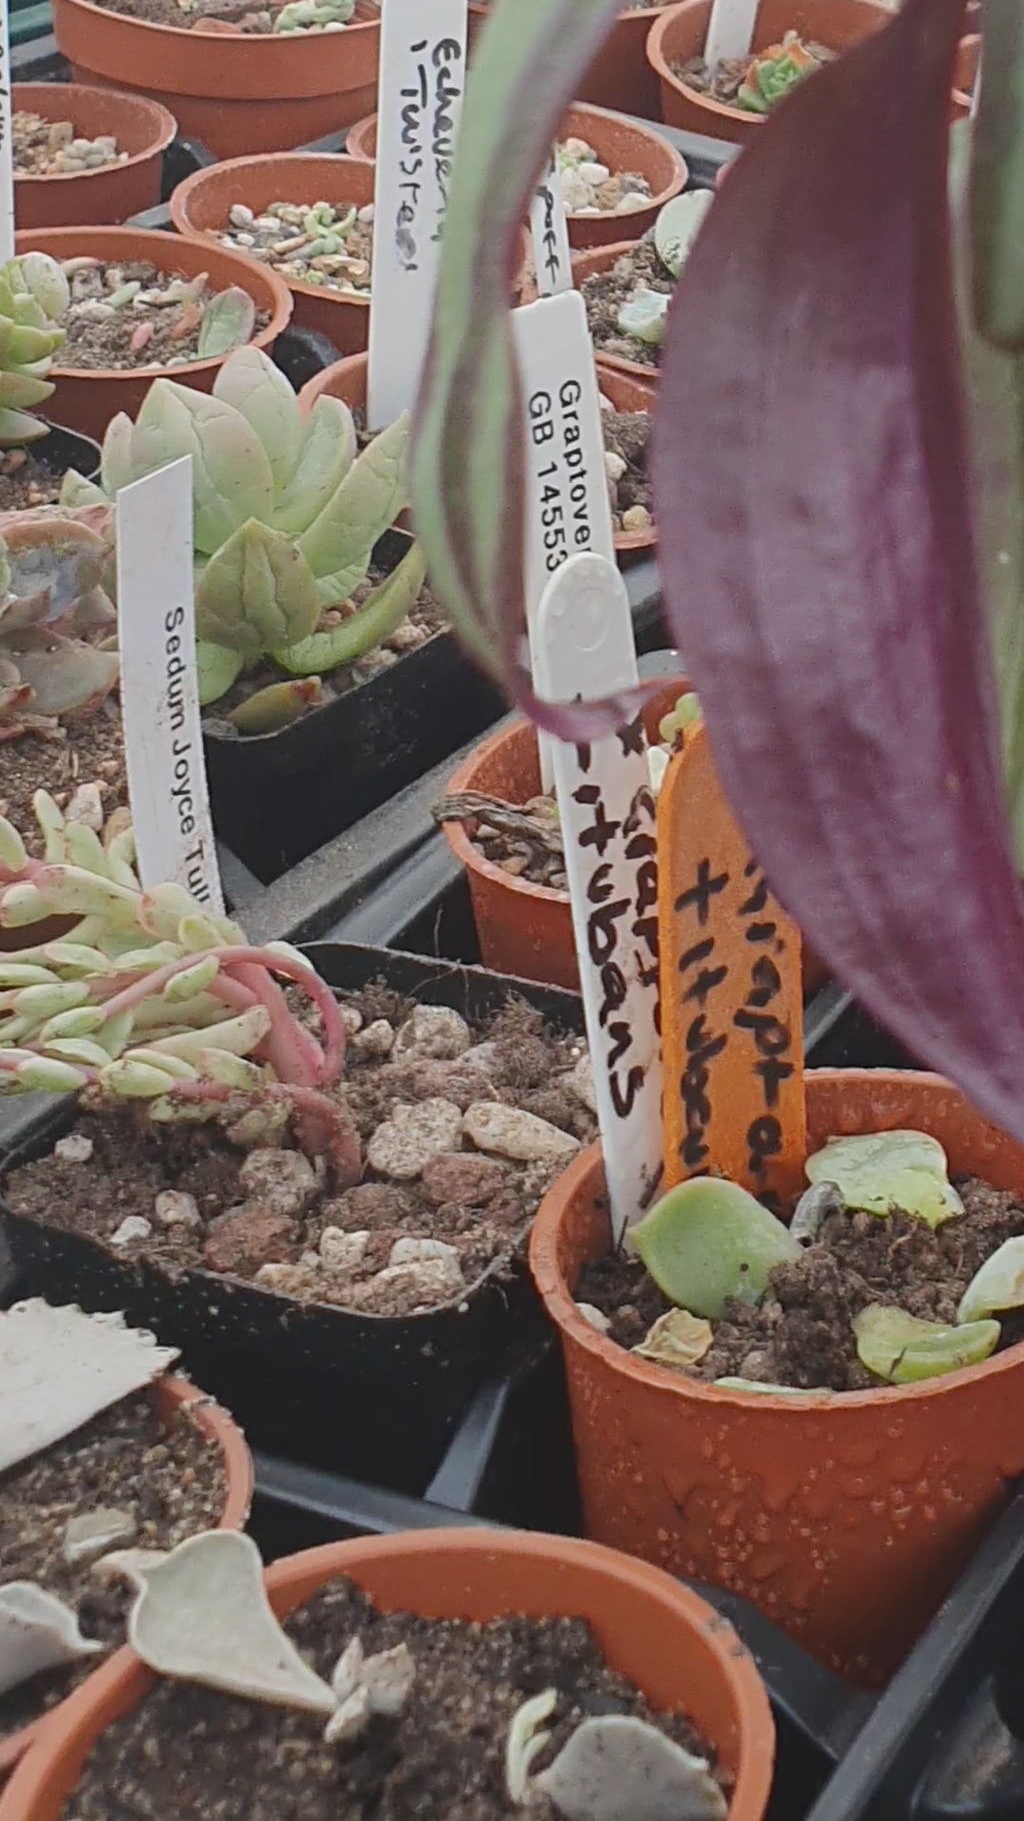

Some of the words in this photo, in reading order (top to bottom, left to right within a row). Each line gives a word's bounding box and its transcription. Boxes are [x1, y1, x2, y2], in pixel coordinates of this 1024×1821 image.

[528, 390, 554, 445] GB
[536, 460, 569, 573] 14553
[164, 605, 187, 732] Sedum
[171, 737, 196, 835] Joyce
